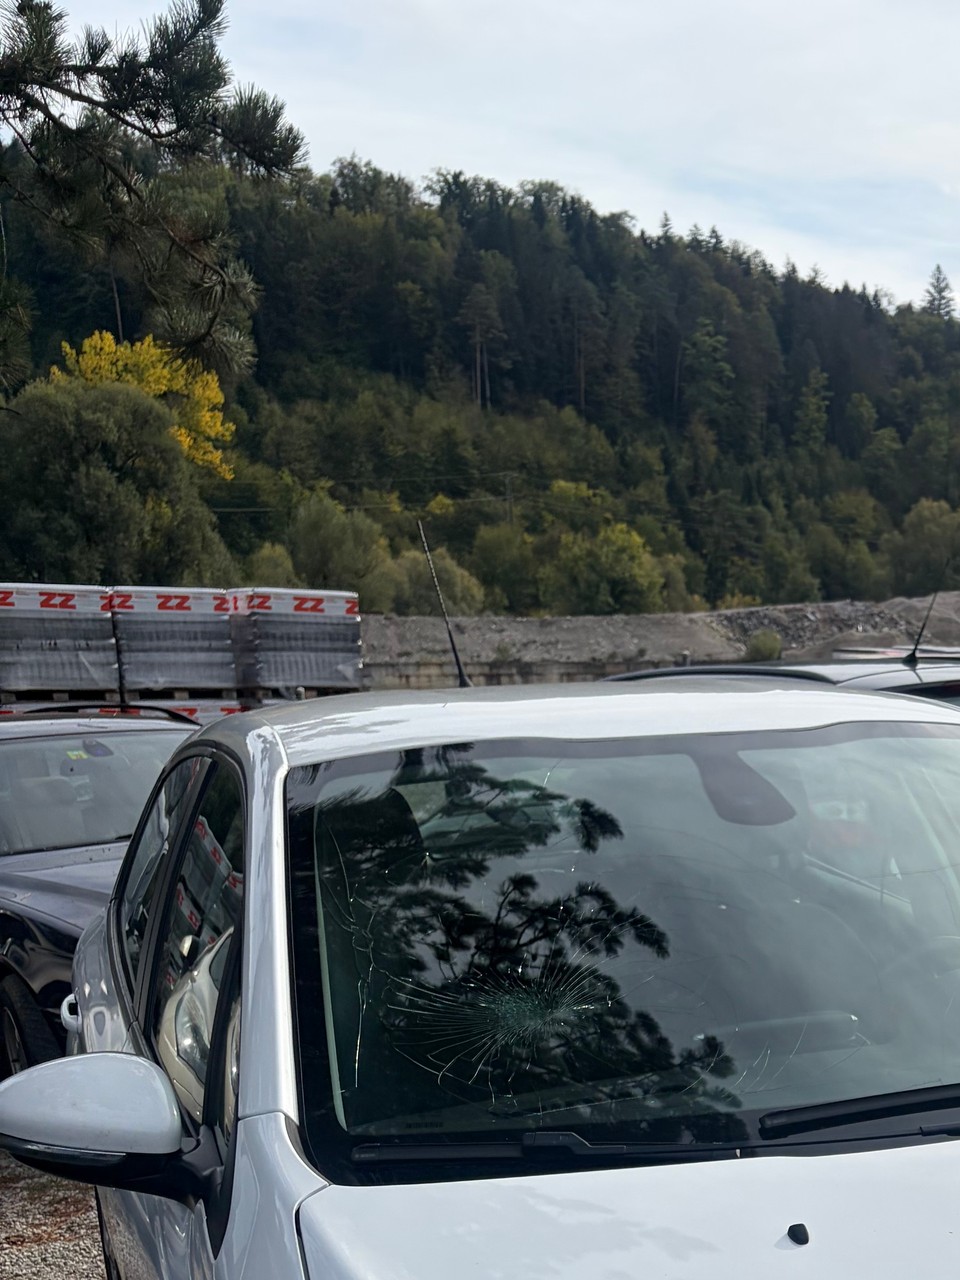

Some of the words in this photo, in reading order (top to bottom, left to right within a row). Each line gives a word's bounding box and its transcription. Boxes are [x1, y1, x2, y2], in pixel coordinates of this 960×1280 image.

[39, 591, 76, 609] ZZ
[156, 594, 192, 611] ZZ
[293, 596, 325, 613] ZZ
